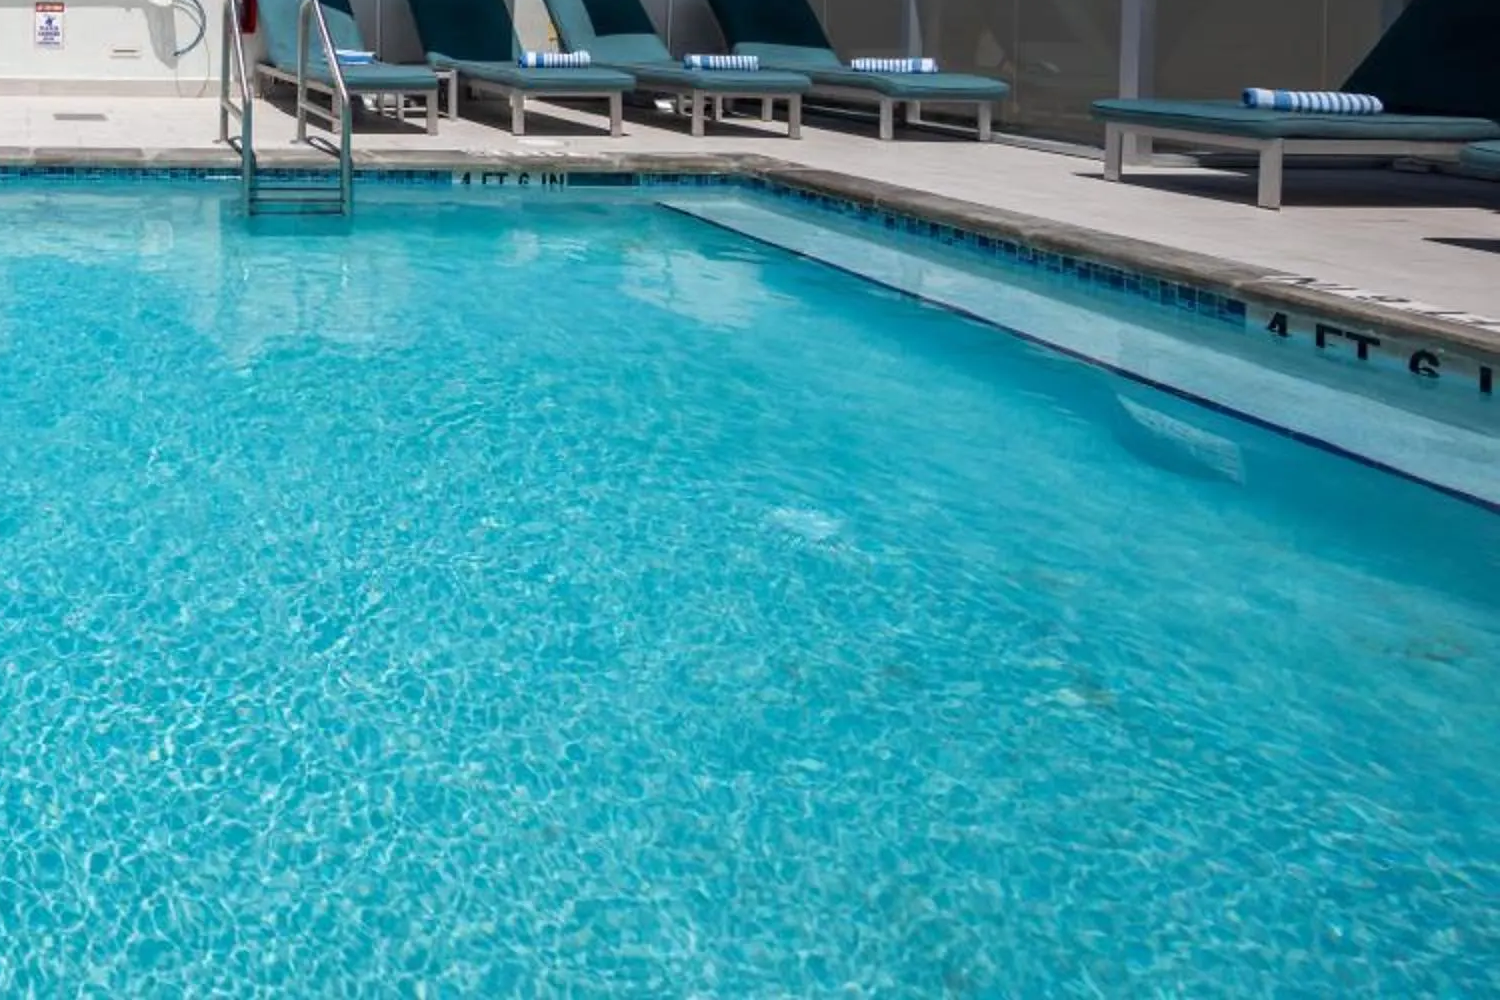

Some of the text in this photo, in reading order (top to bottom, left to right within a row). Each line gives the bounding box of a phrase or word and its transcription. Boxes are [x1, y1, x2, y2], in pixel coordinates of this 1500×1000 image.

[541, 171, 565, 185] IN
[1265, 311, 1289, 338] 4
[1315, 323, 1381, 361] FT
